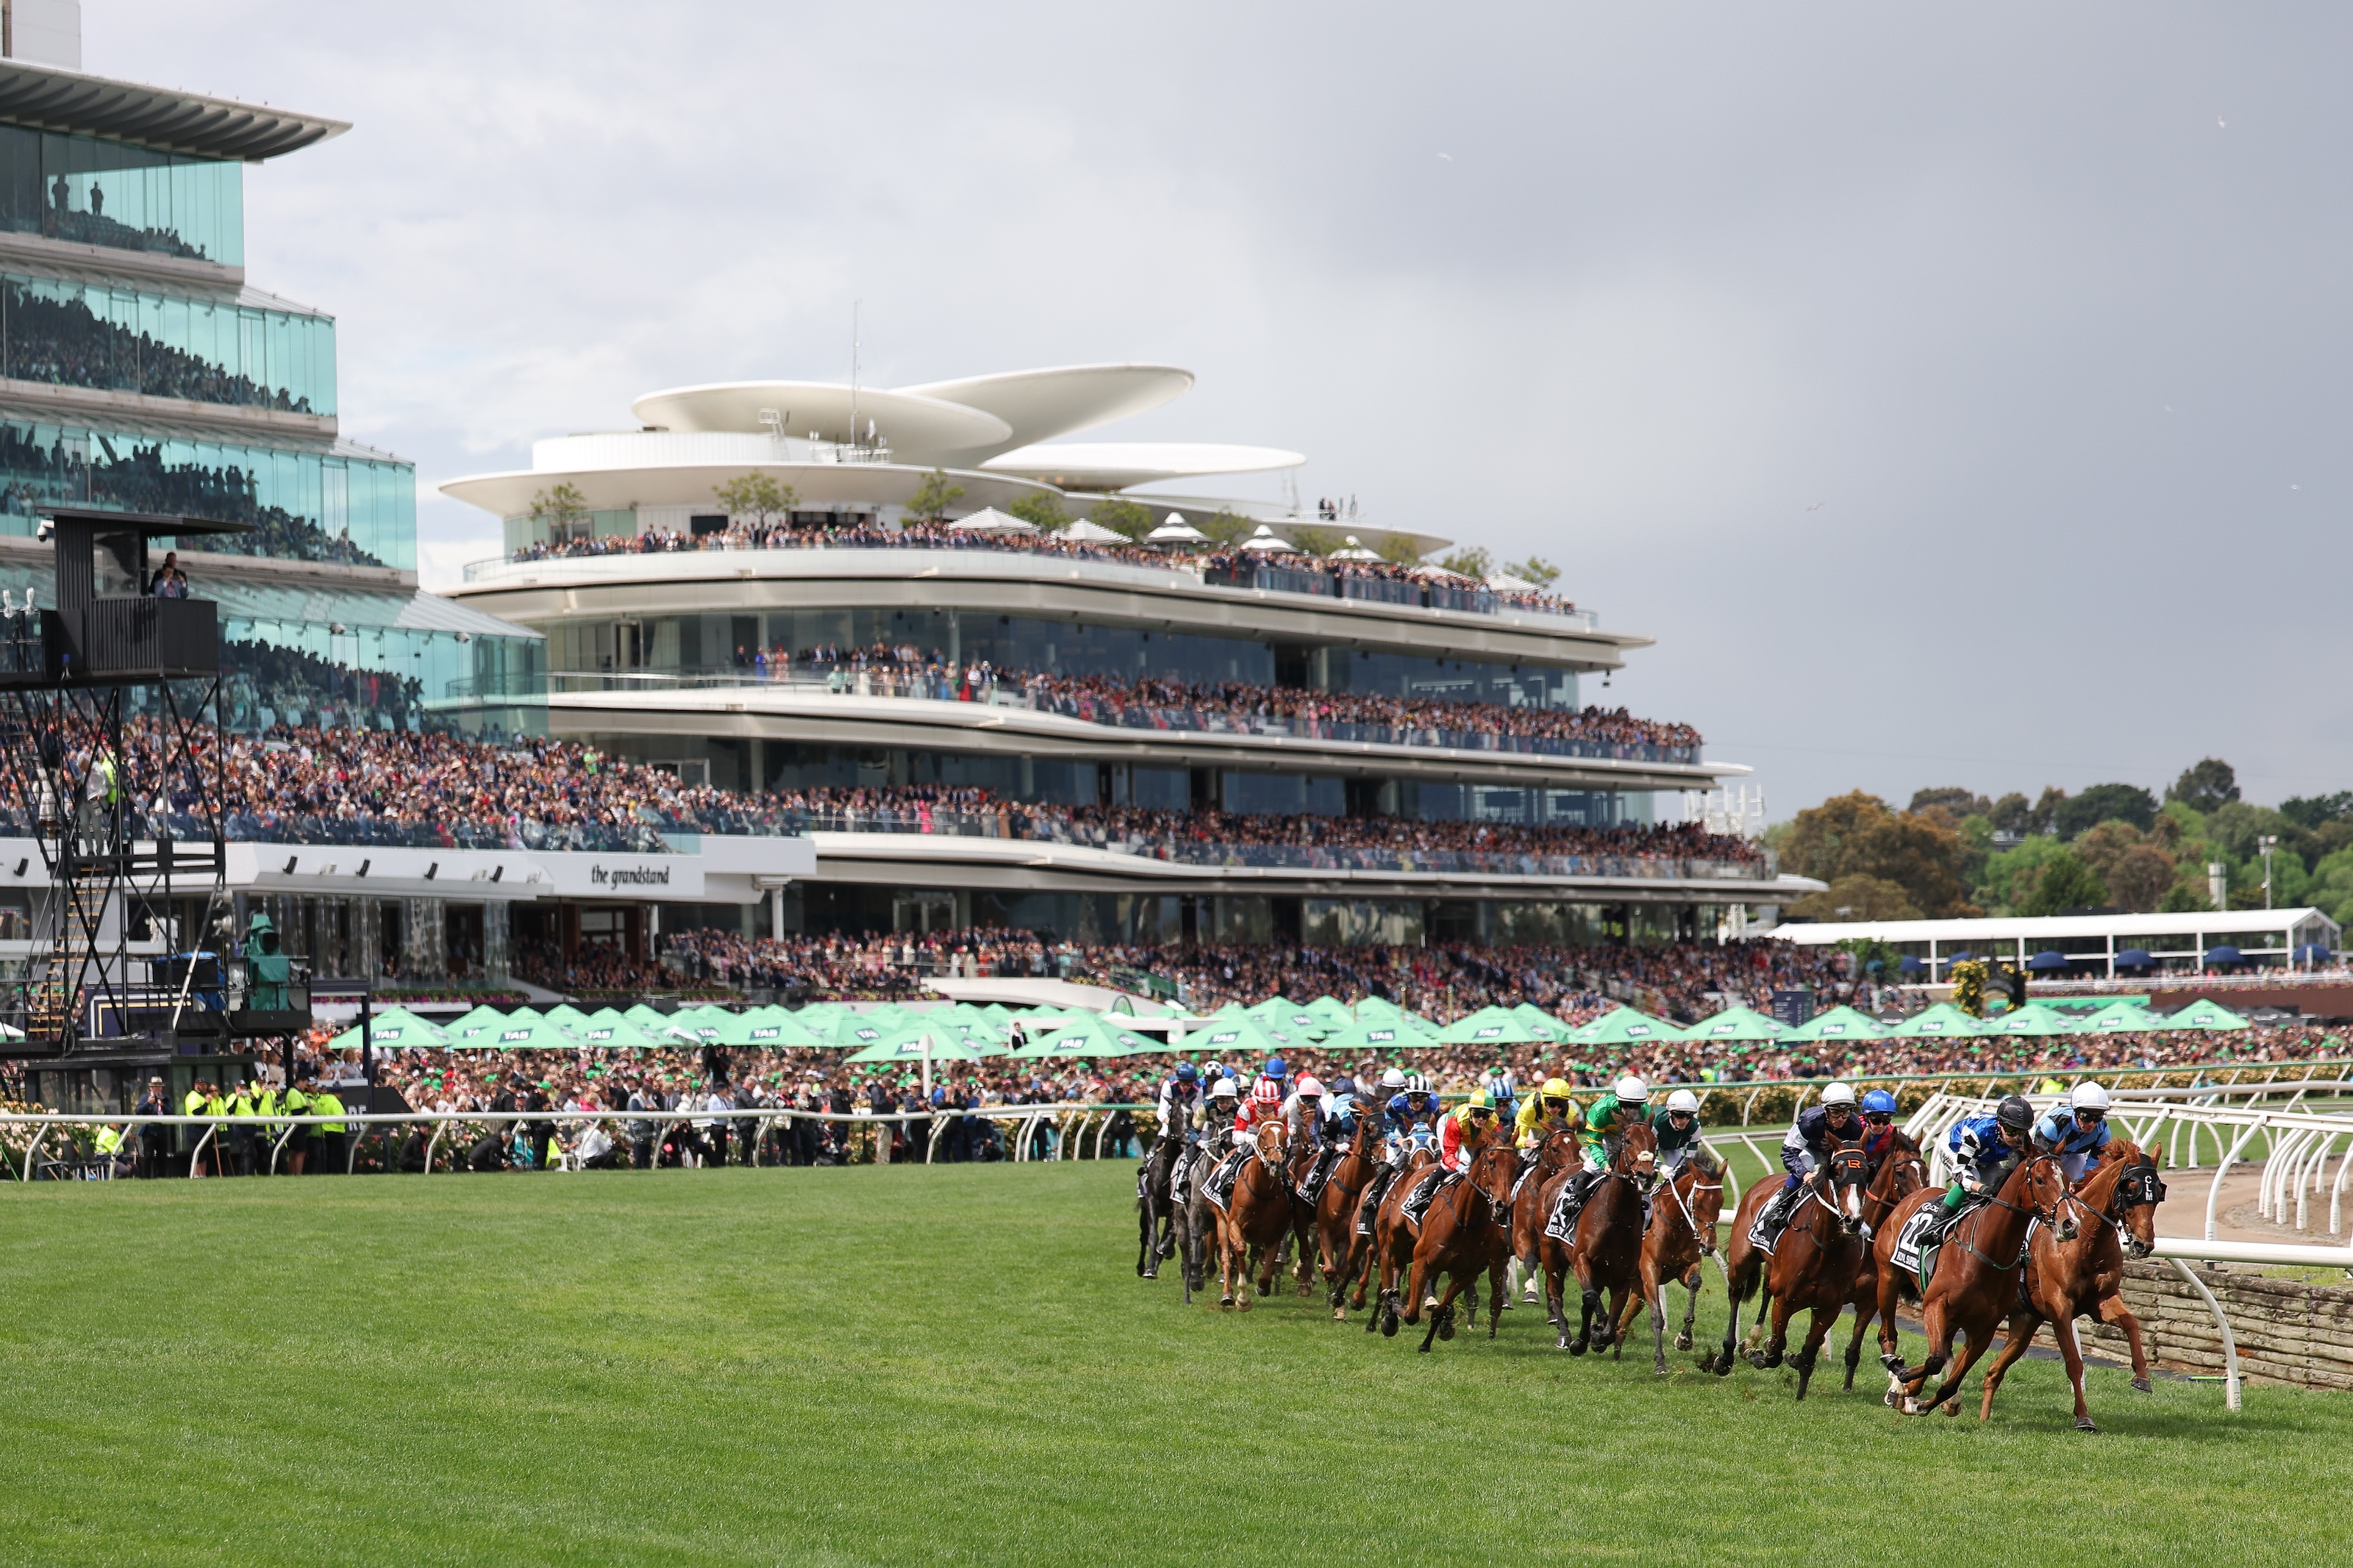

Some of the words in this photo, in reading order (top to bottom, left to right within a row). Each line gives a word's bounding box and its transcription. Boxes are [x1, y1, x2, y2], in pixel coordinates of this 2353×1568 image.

[592, 865, 608, 883] the
[611, 866, 669, 890] grandstand
[374, 1031, 400, 1039] TAB
[504, 1031, 529, 1039] TAB
[587, 1031, 612, 1039] TAB
[752, 1028, 779, 1037] TAB
[1059, 1039, 1084, 1048] TAB
[2144, 1175, 2153, 1201] CLM
